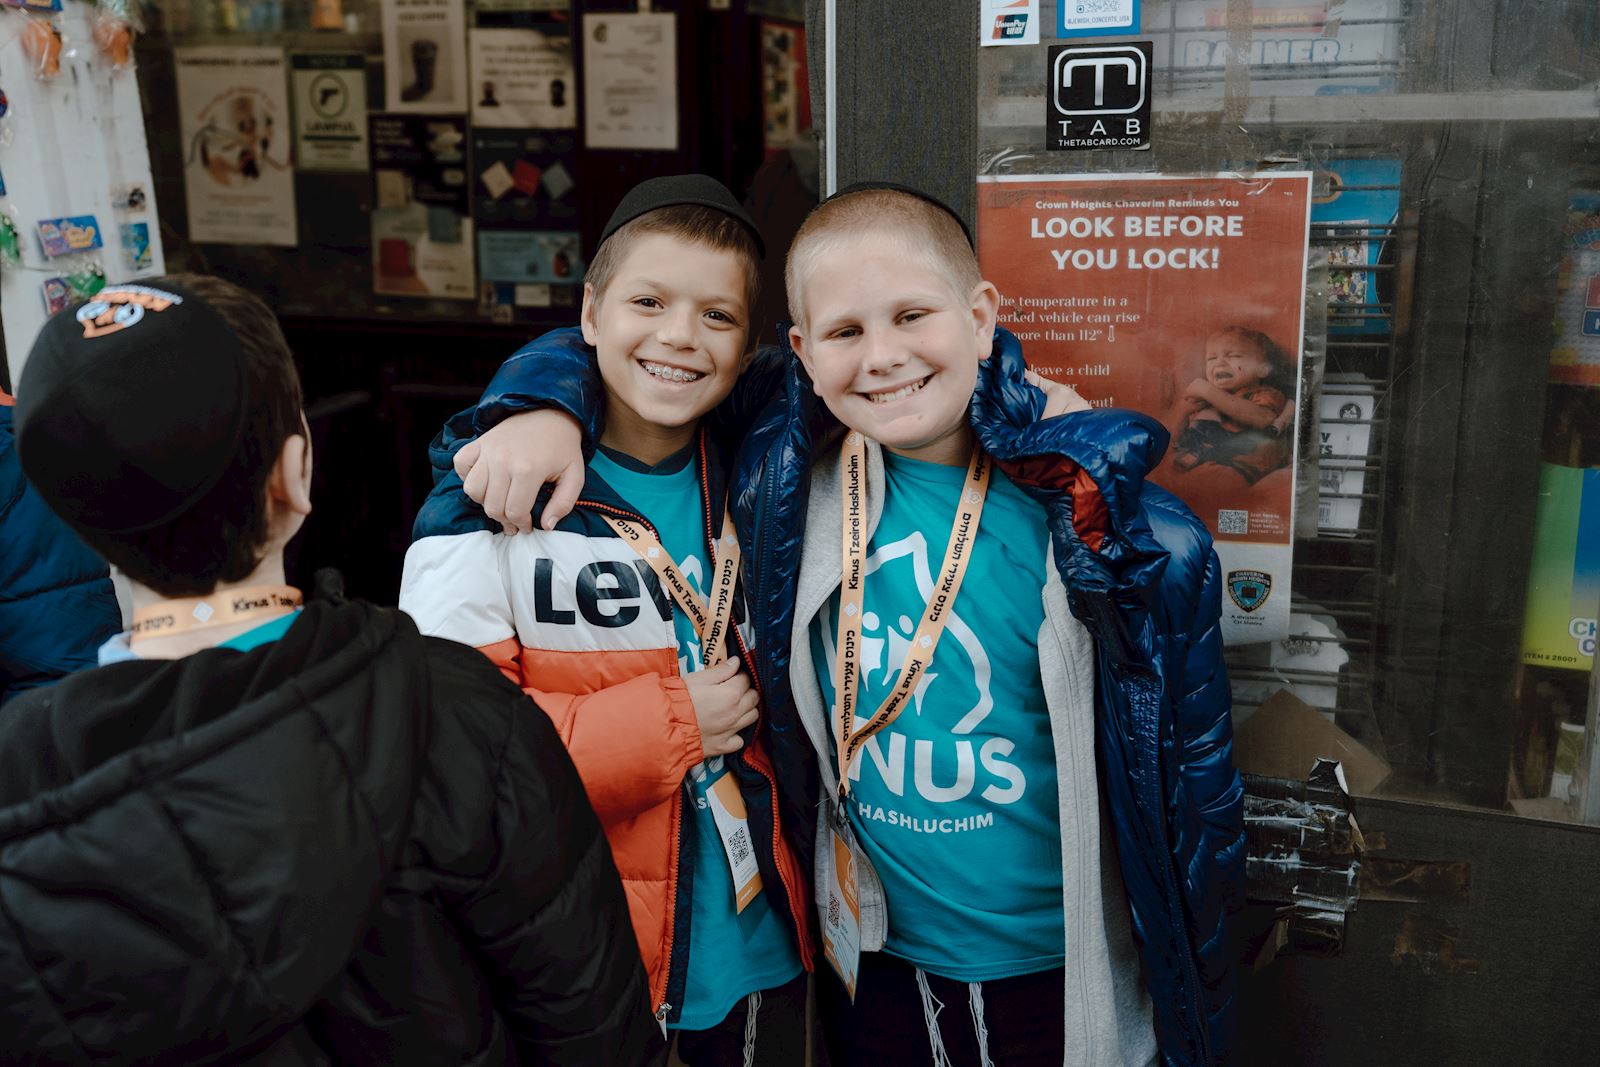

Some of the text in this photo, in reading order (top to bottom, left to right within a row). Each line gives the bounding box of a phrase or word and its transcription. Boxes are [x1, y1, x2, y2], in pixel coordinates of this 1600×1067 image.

[1058, 137, 1141, 147] THETABCARD.COM
[1035, 198, 1240, 210] Crown Heights Chaverim Reminds You
[1031, 215, 1244, 238] LOOK BEFORE
[1051, 248, 1220, 271] YOU LOCK!
[1000, 295, 1128, 310] he temperature in a
[1039, 311, 1084, 323] vehicle
[1087, 314, 1110, 323] can
[1115, 312, 1141, 323] rise
[1045, 329, 1075, 341] than
[1030, 364, 1110, 376] leave a child
[616, 519, 640, 541] כינוס
[848, 454, 861, 590] Kinus Tzeirei Hashluchim
[722, 558, 734, 586] כינוס
[930, 512, 972, 623] כינוס צעירי השלוחים
[233, 598, 269, 613] Kinus
[663, 565, 707, 627] Kinus Tzeirei
[716, 588, 729, 617] צעירי
[845, 629, 855, 659] כינוס
[844, 661, 854, 691] צעירי
[902, 659, 923, 689] Kinus
[878, 691, 908, 723] Tzeirei
[847, 715, 1027, 804] NUS
[858, 802, 994, 834] HASHLUCHIM
